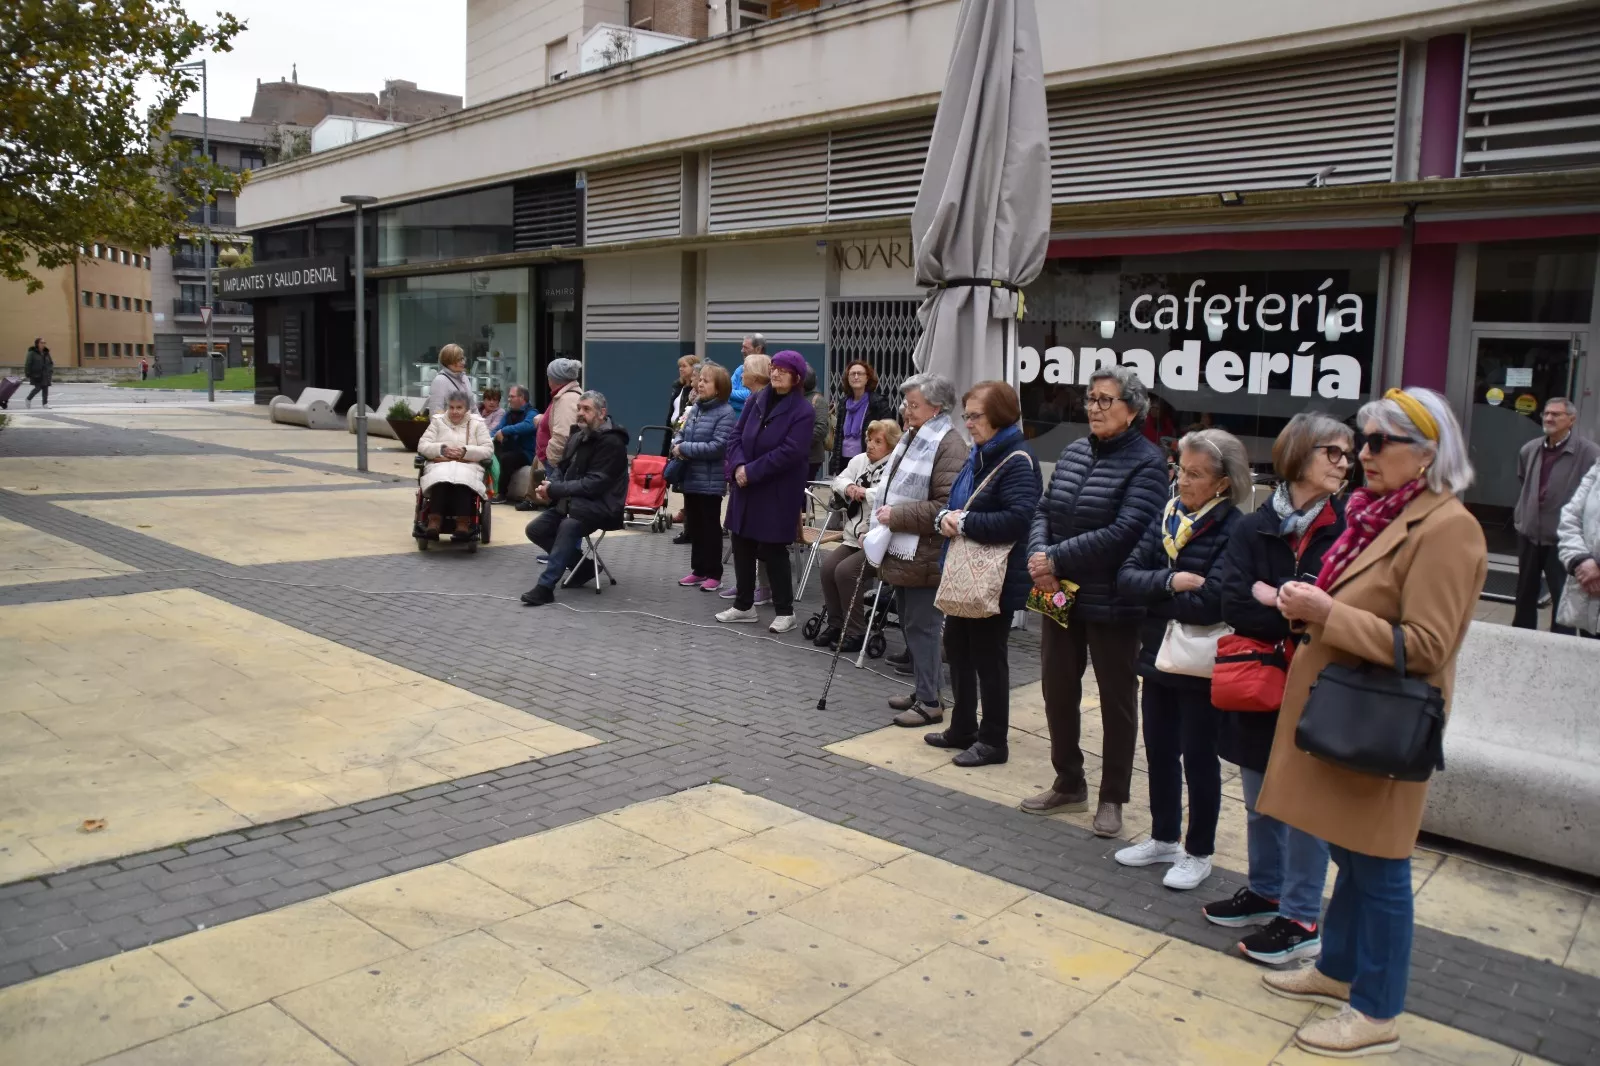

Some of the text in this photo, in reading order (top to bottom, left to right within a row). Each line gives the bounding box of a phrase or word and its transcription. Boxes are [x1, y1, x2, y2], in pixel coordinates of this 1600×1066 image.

[223, 266, 337, 292] IMPLANTES Y SALUD DENTAL
[545, 287, 575, 296] RAMIRO
[1129, 278, 1364, 332] cafetería
[1018, 339, 1362, 400] panadería
